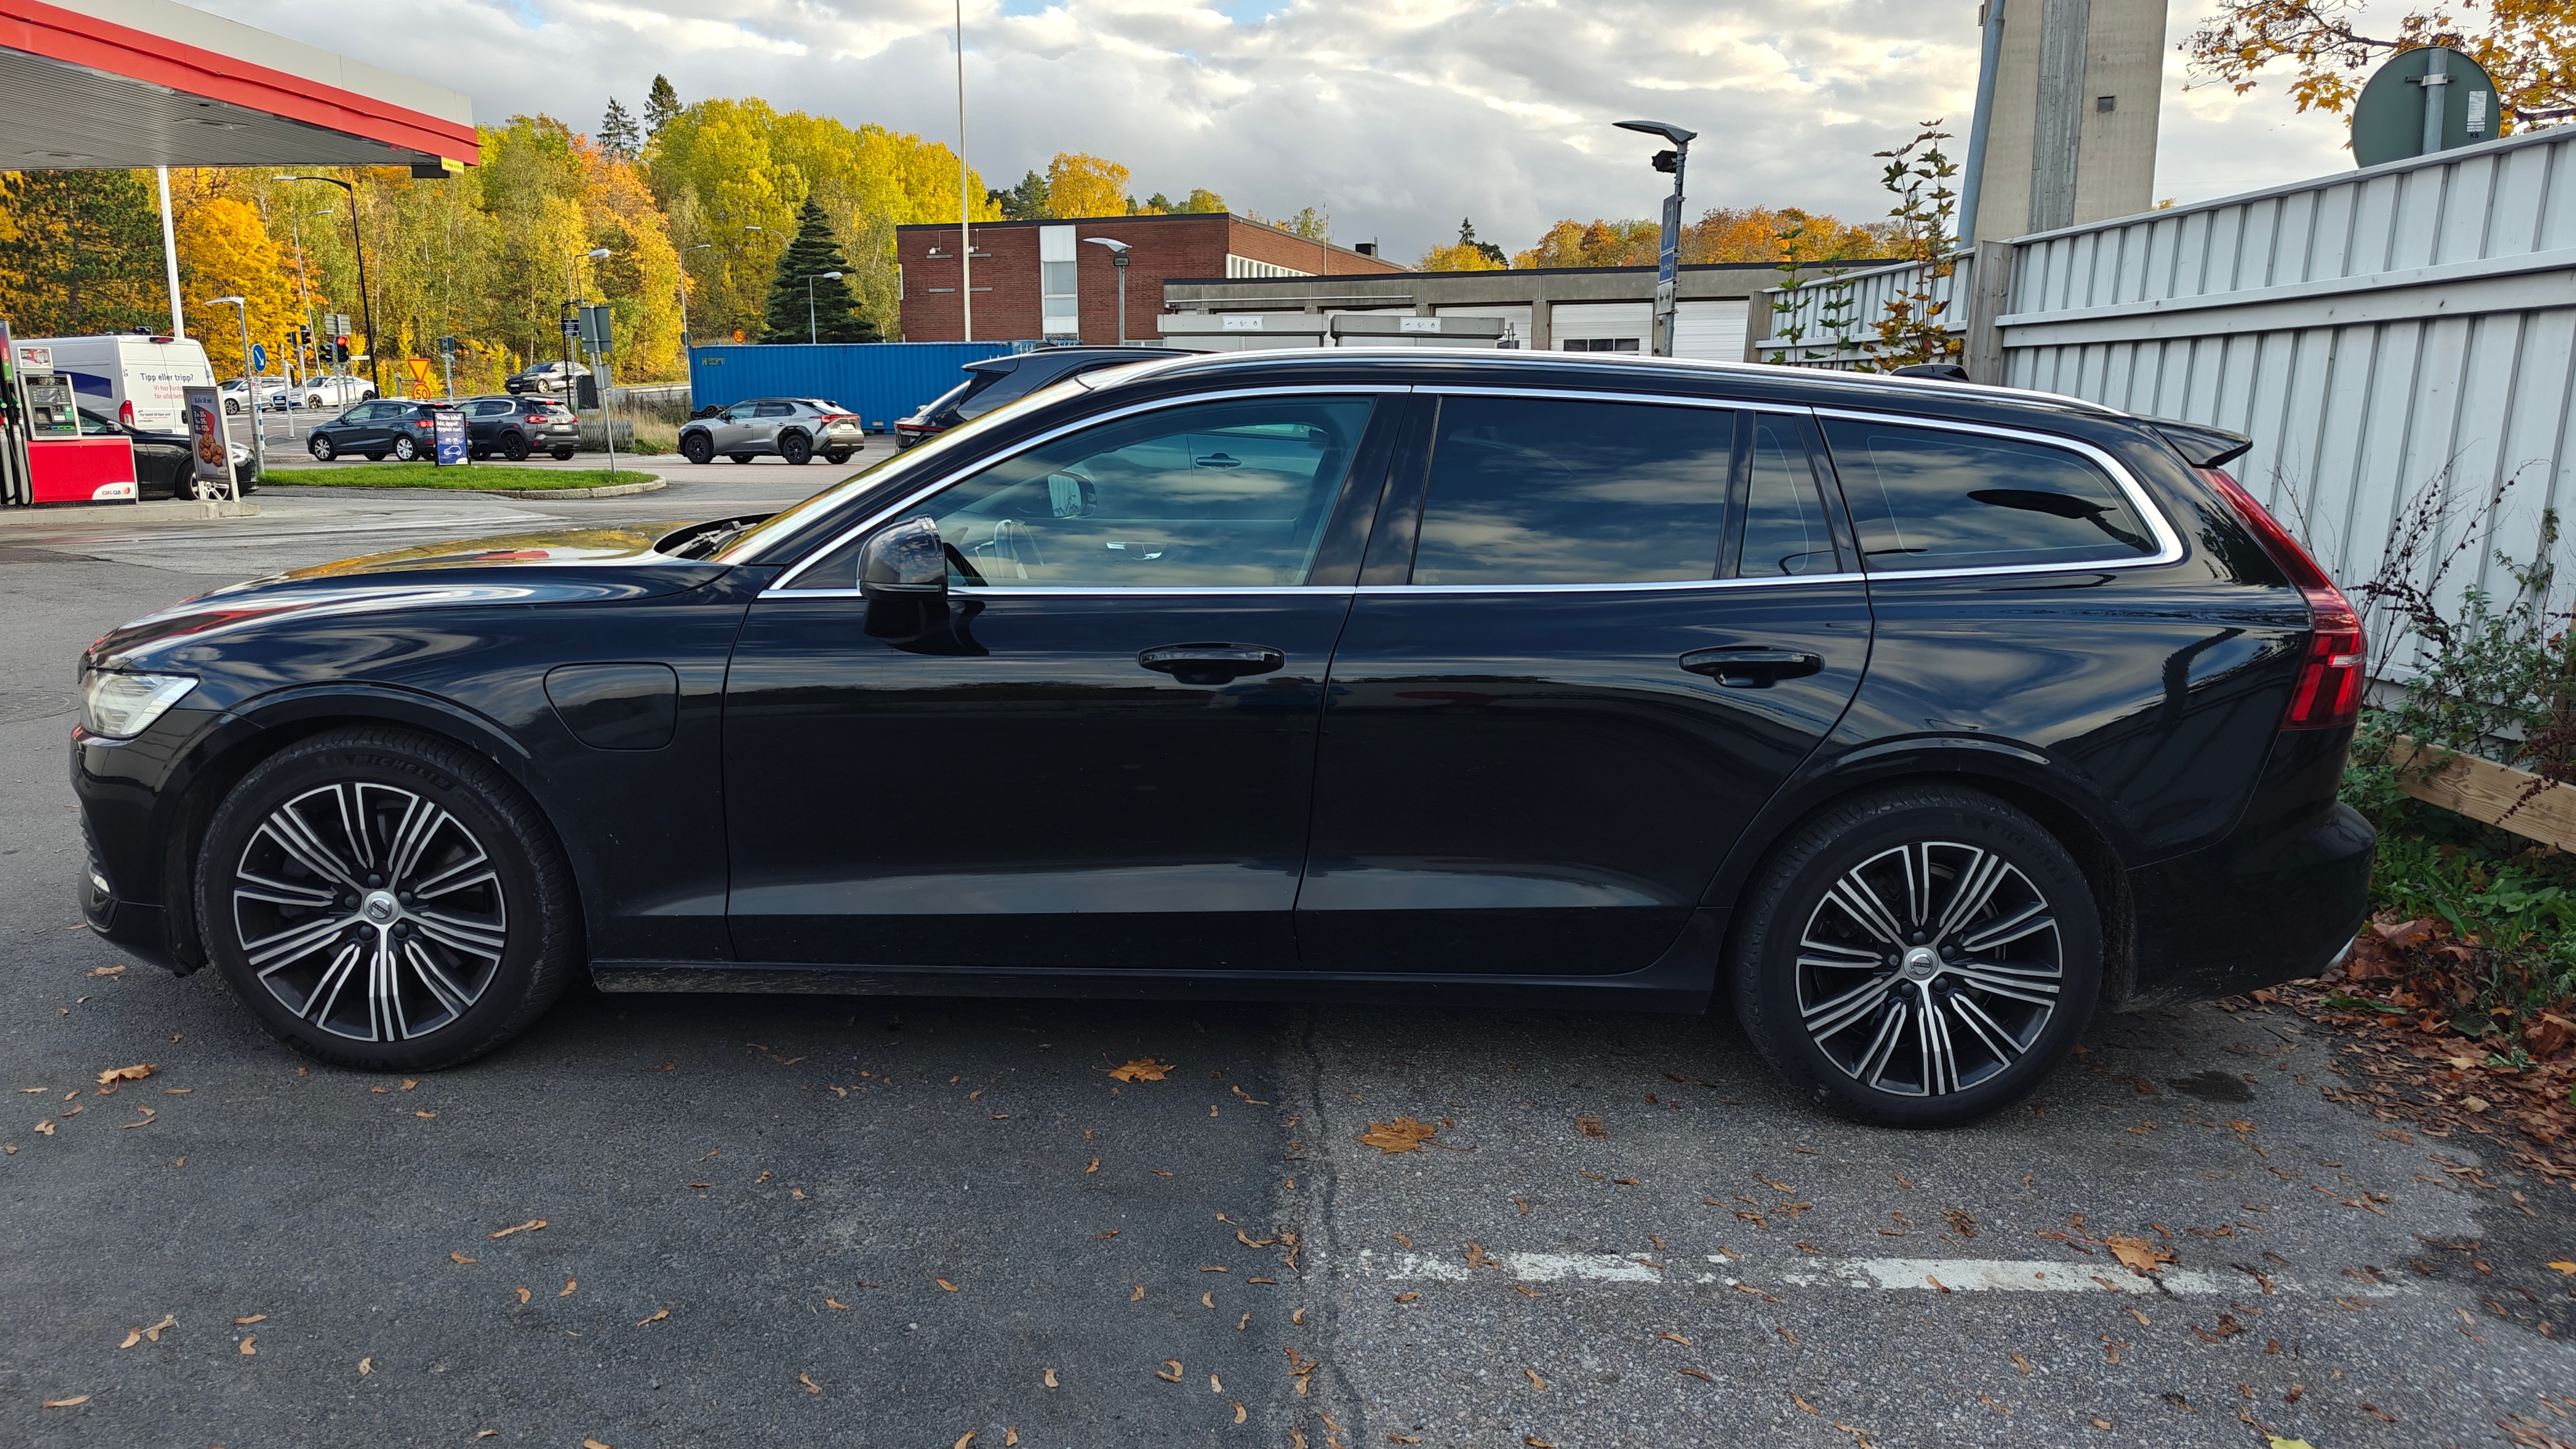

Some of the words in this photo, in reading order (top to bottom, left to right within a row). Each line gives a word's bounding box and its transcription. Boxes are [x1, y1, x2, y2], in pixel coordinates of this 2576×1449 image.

[140, 372, 157, 382] Tipp
[158, 373, 173, 381] eller
[174, 374, 194, 383] tripp?
[416, 389, 428, 399] 50
[353, 755, 450, 786] MICHELIN
